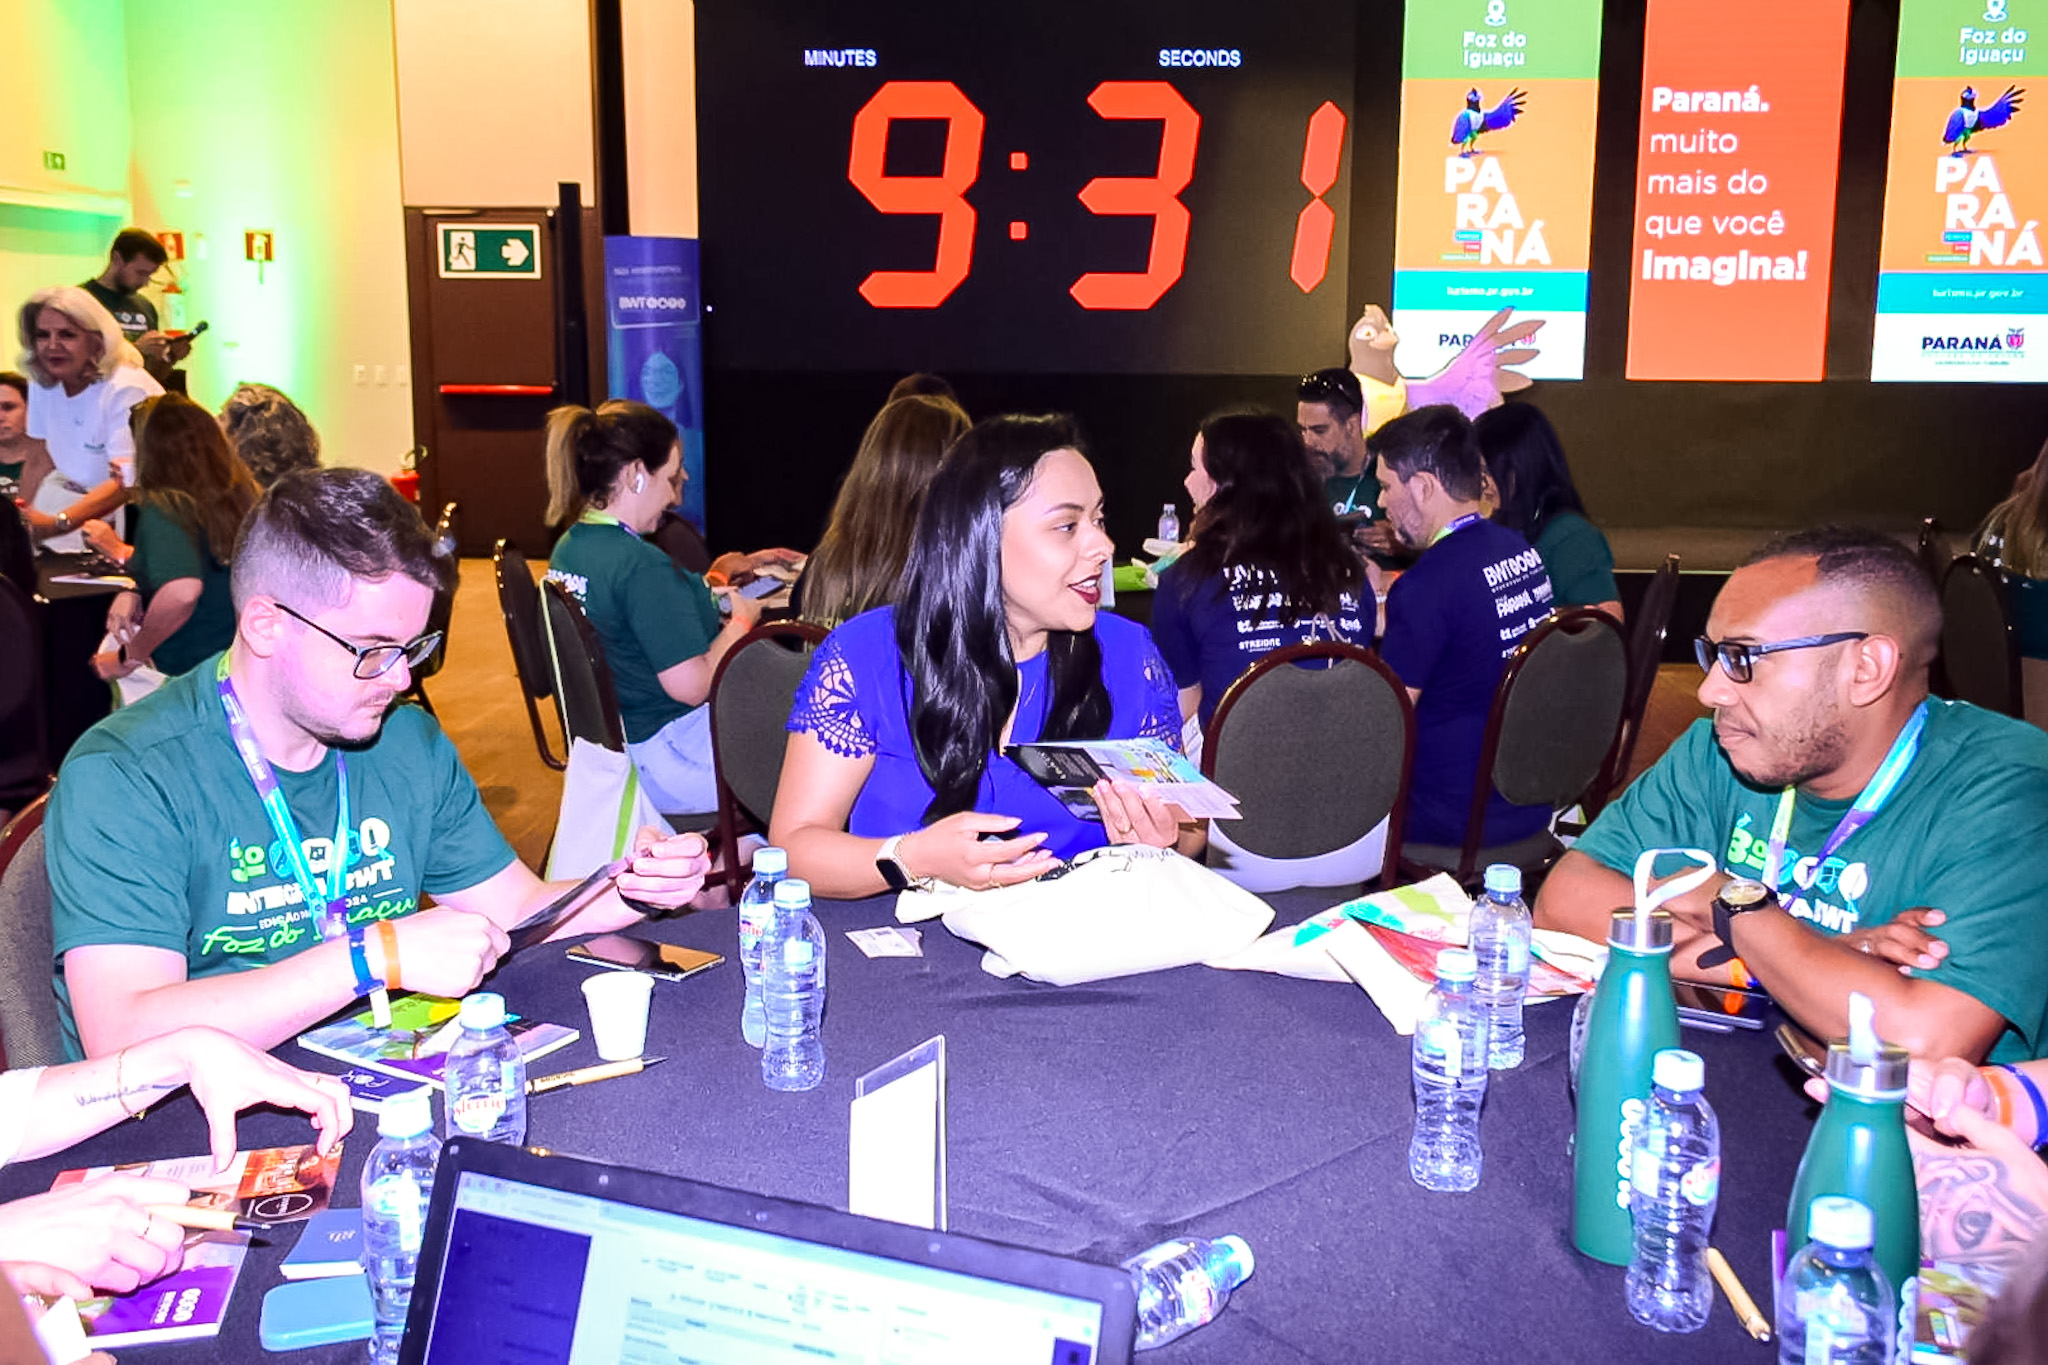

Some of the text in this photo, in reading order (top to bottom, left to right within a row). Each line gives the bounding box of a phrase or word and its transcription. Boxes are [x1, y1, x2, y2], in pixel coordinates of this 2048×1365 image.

[1463, 30, 1527, 48] Foz do
[1960, 27, 2027, 44] Foz do
[804, 49, 877, 67] MINUTES
[1159, 49, 1242, 67] SECONDS
[1463, 50, 1525, 68] Iguaçu
[1960, 46, 2025, 65] Iguaçu
[1652, 84, 1769, 112] Paraná.
[1650, 128, 1738, 153] muito
[1648, 168, 1768, 194] mais do
[1645, 209, 1785, 239] que você
[1922, 334, 2002, 350] PARANÁ
[202, 926, 266, 956] Foz
[270, 920, 305, 949] do
